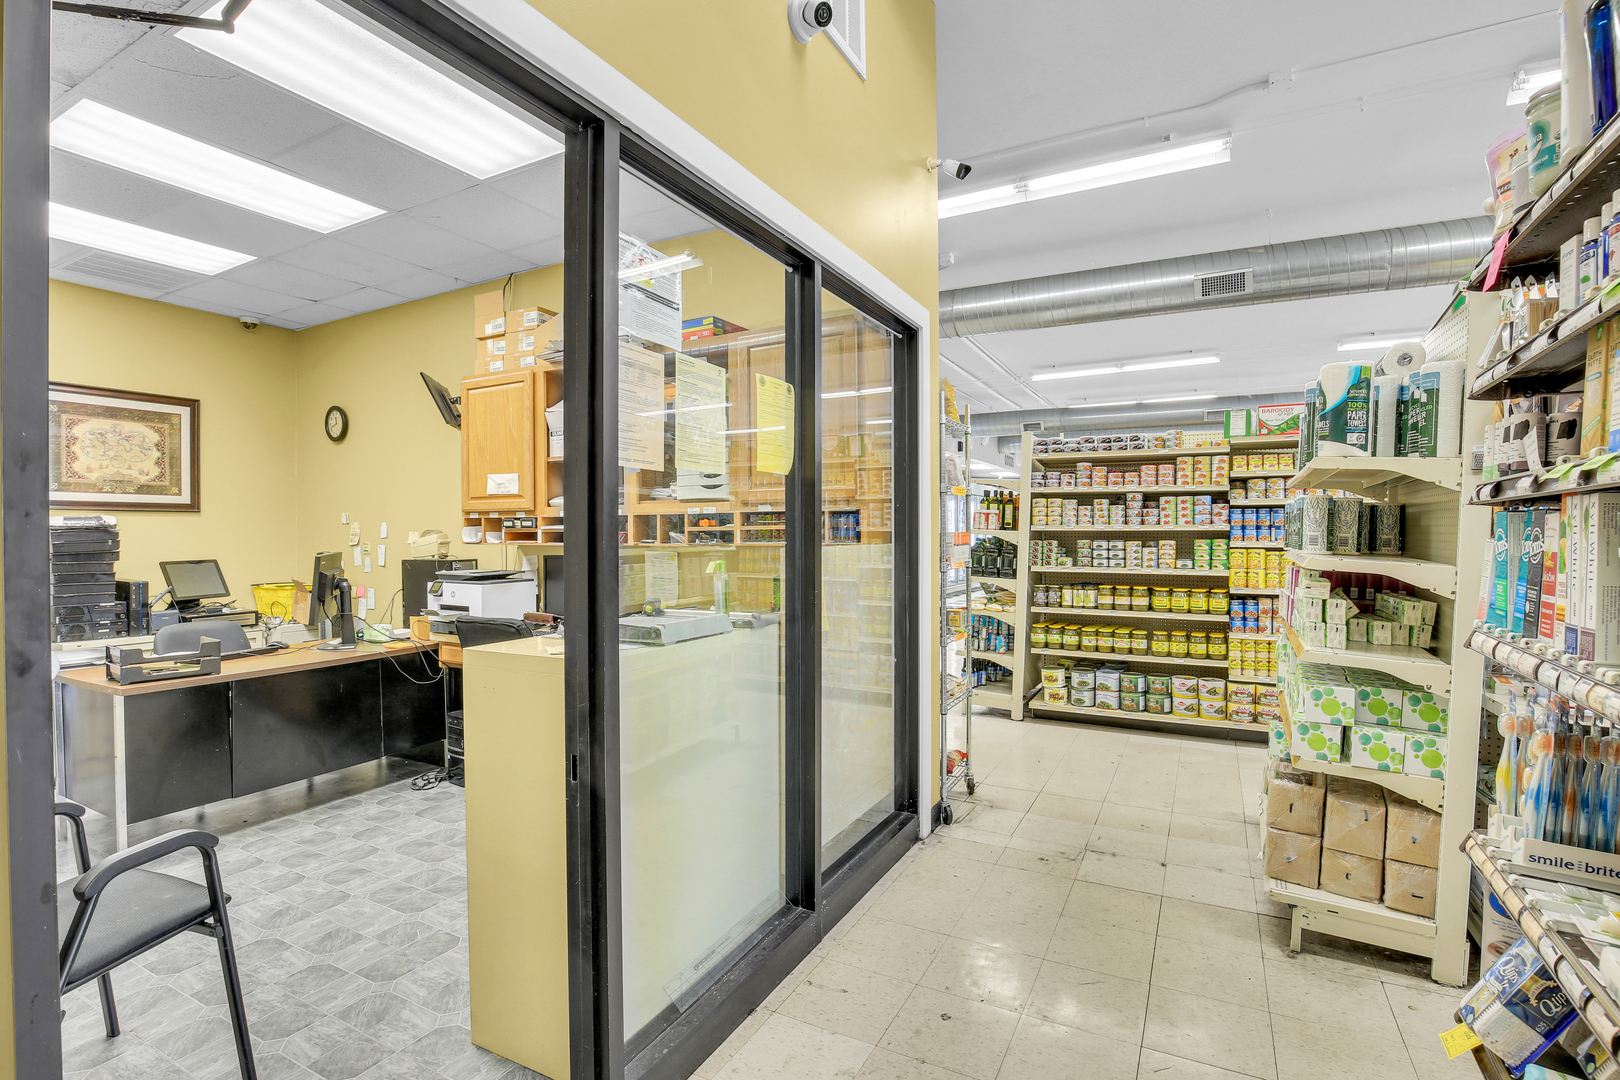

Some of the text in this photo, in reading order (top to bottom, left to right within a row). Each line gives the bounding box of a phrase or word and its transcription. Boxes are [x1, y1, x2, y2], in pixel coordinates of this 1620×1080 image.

[1588, 349, 1602, 362] EARTH
[1347, 411, 1367, 420] PAPER
[1528, 854, 1575, 870] smile
[1535, 1021, 1547, 1033] 625
